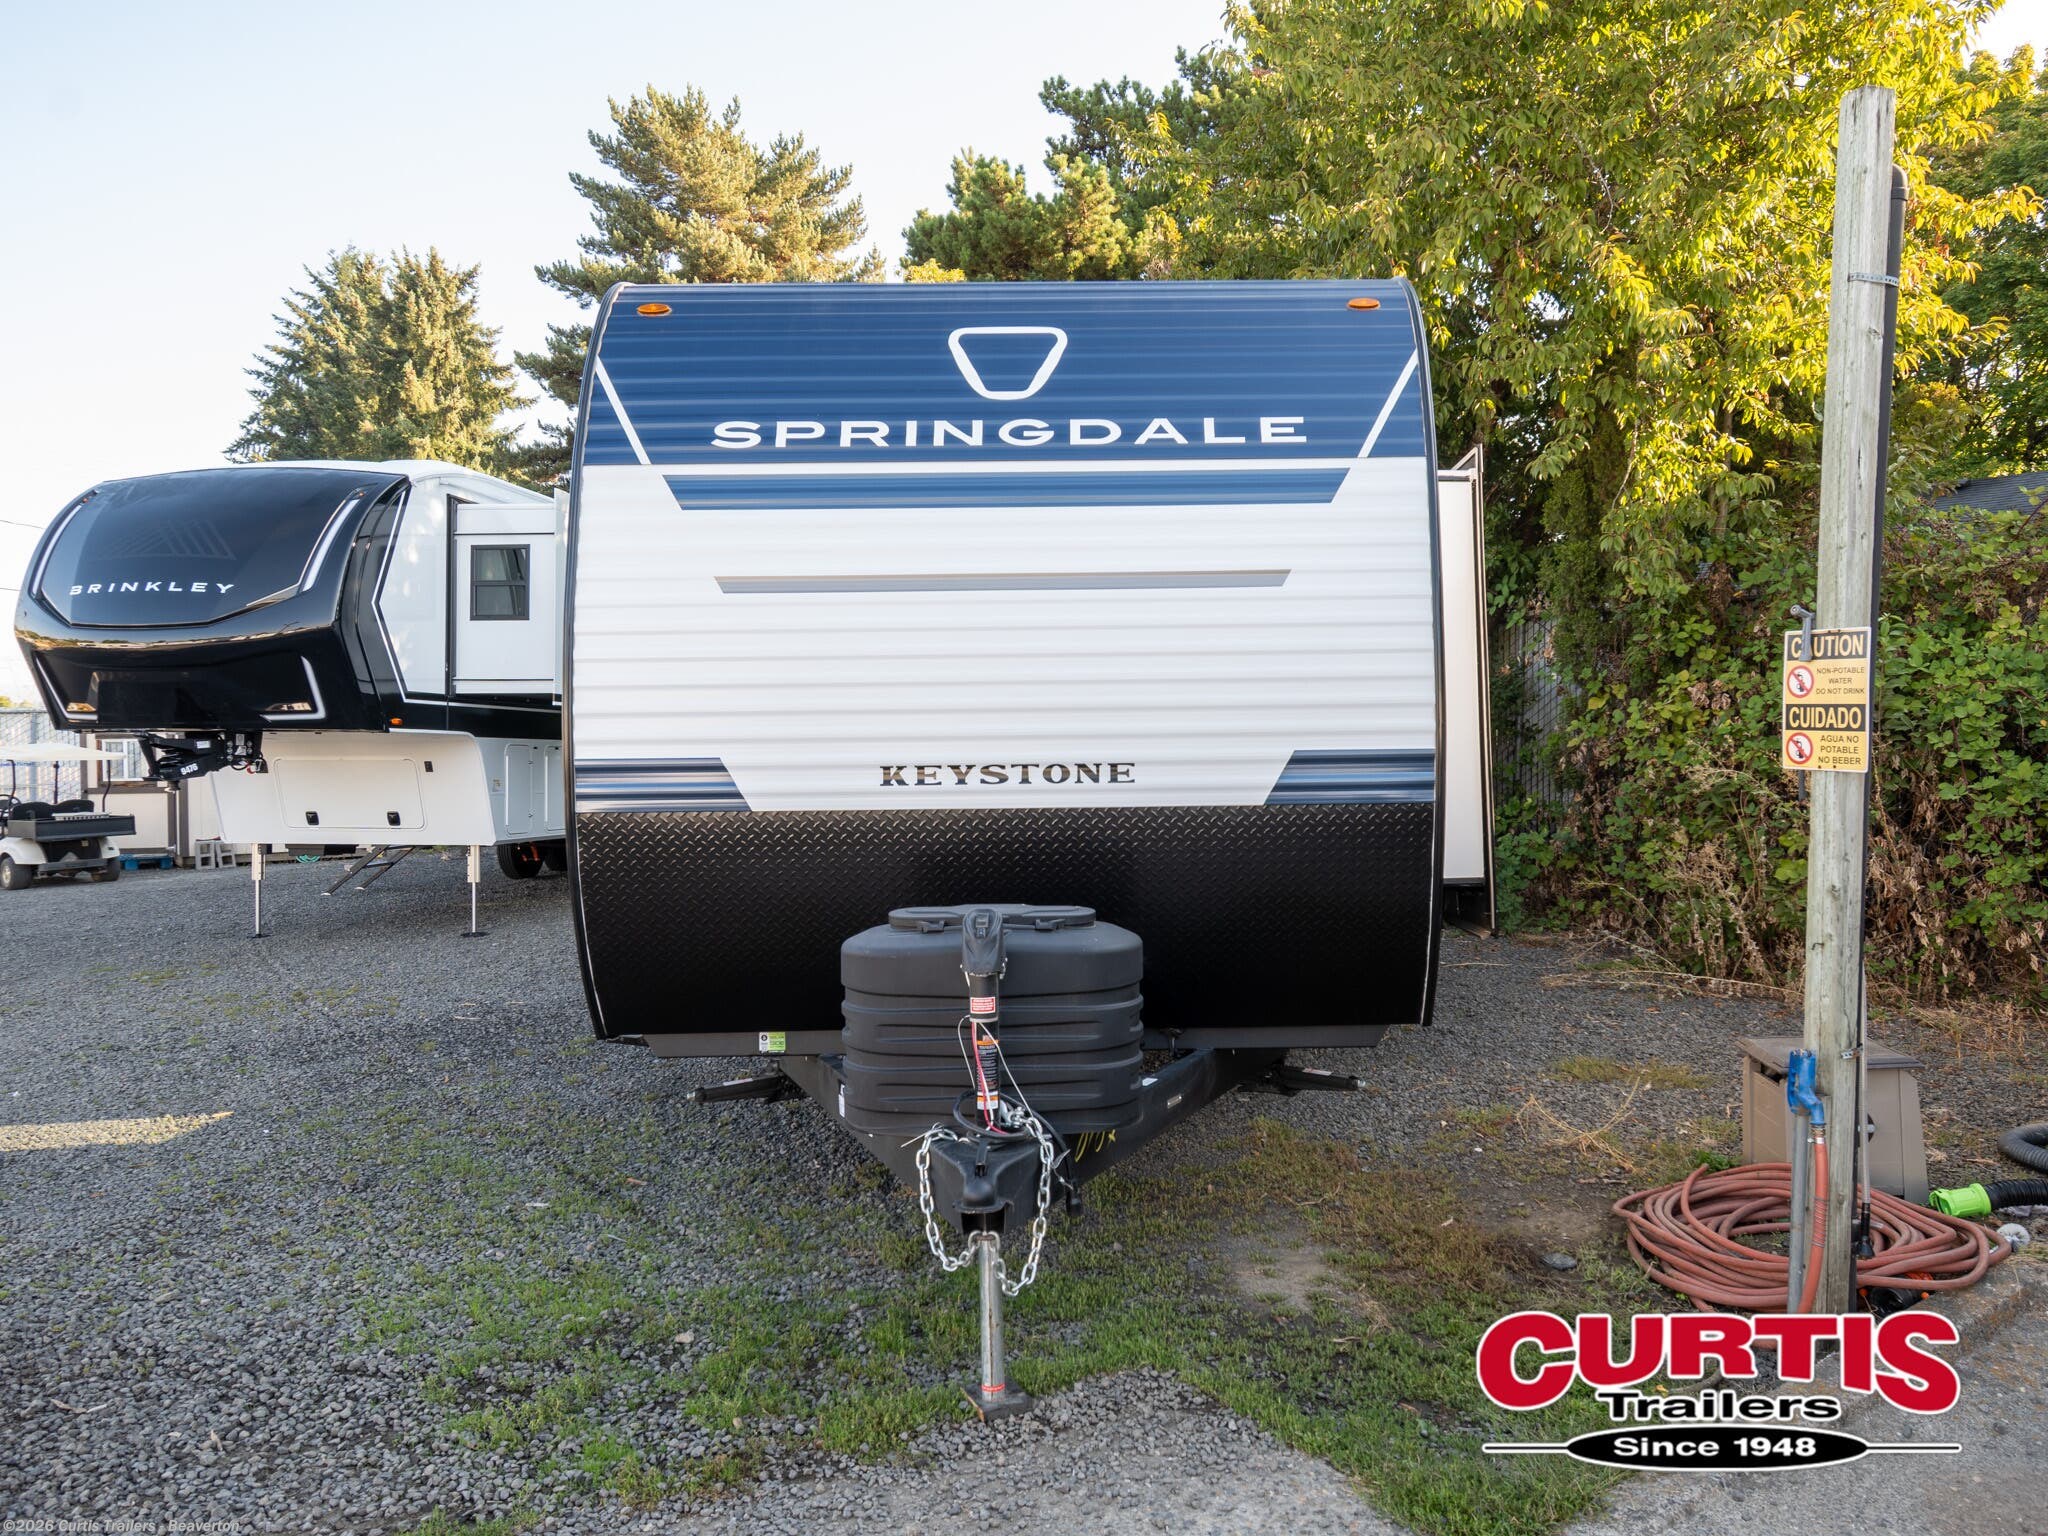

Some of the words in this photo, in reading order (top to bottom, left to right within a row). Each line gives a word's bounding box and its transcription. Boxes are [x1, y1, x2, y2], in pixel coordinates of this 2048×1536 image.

[711, 416, 1307, 449] SPRINGDALE
[69, 582, 234, 595] BRINKLEY
[1791, 634, 1864, 658] CUTION
[1816, 667, 1865, 675] NON-POTABLE
[1789, 706, 1862, 729] CUIDADO
[1820, 735, 1845, 743] AGUA
[1846, 735, 1859, 743] NO
[1820, 745, 1860, 754] POTABLE
[1818, 756, 1831, 764] NO
[1832, 757, 1862, 765] BEBER
[880, 762, 1135, 786] KEYSTONE
